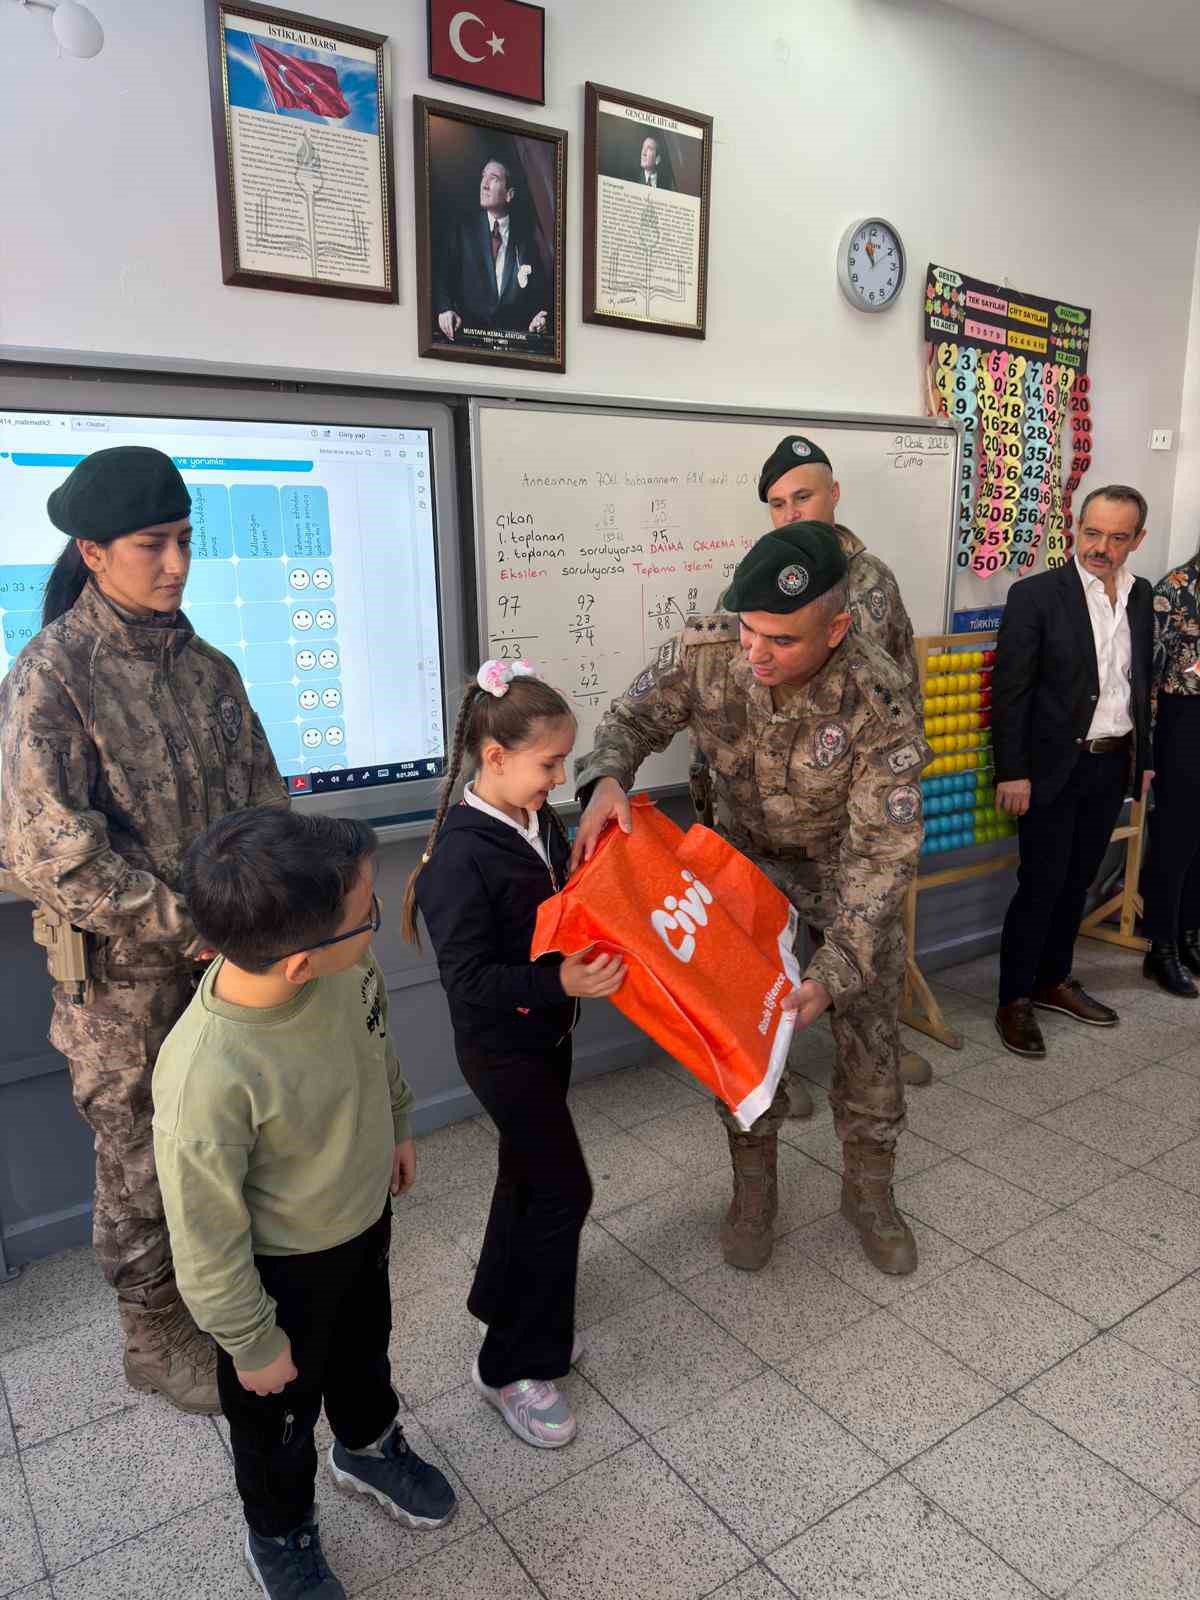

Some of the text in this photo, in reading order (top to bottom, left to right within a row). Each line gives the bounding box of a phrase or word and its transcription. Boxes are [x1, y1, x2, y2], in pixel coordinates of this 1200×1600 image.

[268, 24, 337, 52] İSTİKLAL MARŞI
[968, 295, 1006, 312] TEK SAYILAR
[943, 350, 952, 366] 2
[961, 354, 971, 370] 3
[991, 356, 1000, 372] 5
[1008, 363, 1017, 378] 6
[1031, 368, 1039, 382] 7
[1045, 370, 1053, 385] 8
[938, 375, 947, 391] 4
[955, 376, 966, 391] 6
[1060, 372, 1069, 386] 9
[1073, 377, 1088, 393] 10
[1025, 385, 1042, 401] 14
[955, 398, 967, 414] 9
[979, 393, 996, 411] 12
[1001, 402, 1021, 418] 18
[1072, 398, 1089, 412] 20
[1027, 406, 1044, 422] 21
[963, 417, 974, 432] 2
[983, 414, 999, 432] 16
[1000, 420, 1019, 436] 24
[1073, 417, 1091, 430] 30
[1027, 426, 1048, 441] 28
[963, 443, 973, 458] 5
[984, 434, 999, 452] 20
[1073, 437, 1090, 453] 40
[1027, 446, 1048, 462] 35
[1023, 464, 1045, 479] 42
[1072, 456, 1090, 472] 50
[962, 466, 972, 480] 8
[1006, 466, 1018, 481] 6
[961, 485, 970, 499] 1
[992, 485, 1002, 500] 5
[1004, 485, 1017, 500] 2
[1020, 487, 1039, 502] 49
[960, 506, 971, 522] 4
[990, 506, 1001, 522] 0
[1001, 507, 1014, 522] 8
[1018, 508, 1038, 523] 56
[1050, 515, 1064, 530] 72
[511, 530, 565, 548] toplanan
[652, 528, 669, 543] 95
[961, 529, 971, 544] 7
[1013, 529, 1033, 543] 63
[1048, 535, 1064, 550] 81
[514, 547, 565, 564] toplanan
[580, 543, 643, 562] soruluyorsa
[957, 551, 969, 567] 0
[973, 555, 998, 571] 50
[500, 567, 548, 580] Eksilen
[561, 562, 625, 581] soruluyorsa
[723, 563, 737, 577] ya
[12, 582, 25, 592] 33
[498, 595, 521, 618] 97
[577, 594, 595, 612] 97
[18, 628, 33, 639] 90
[575, 630, 594, 646] 74
[501, 643, 522, 659] 23
